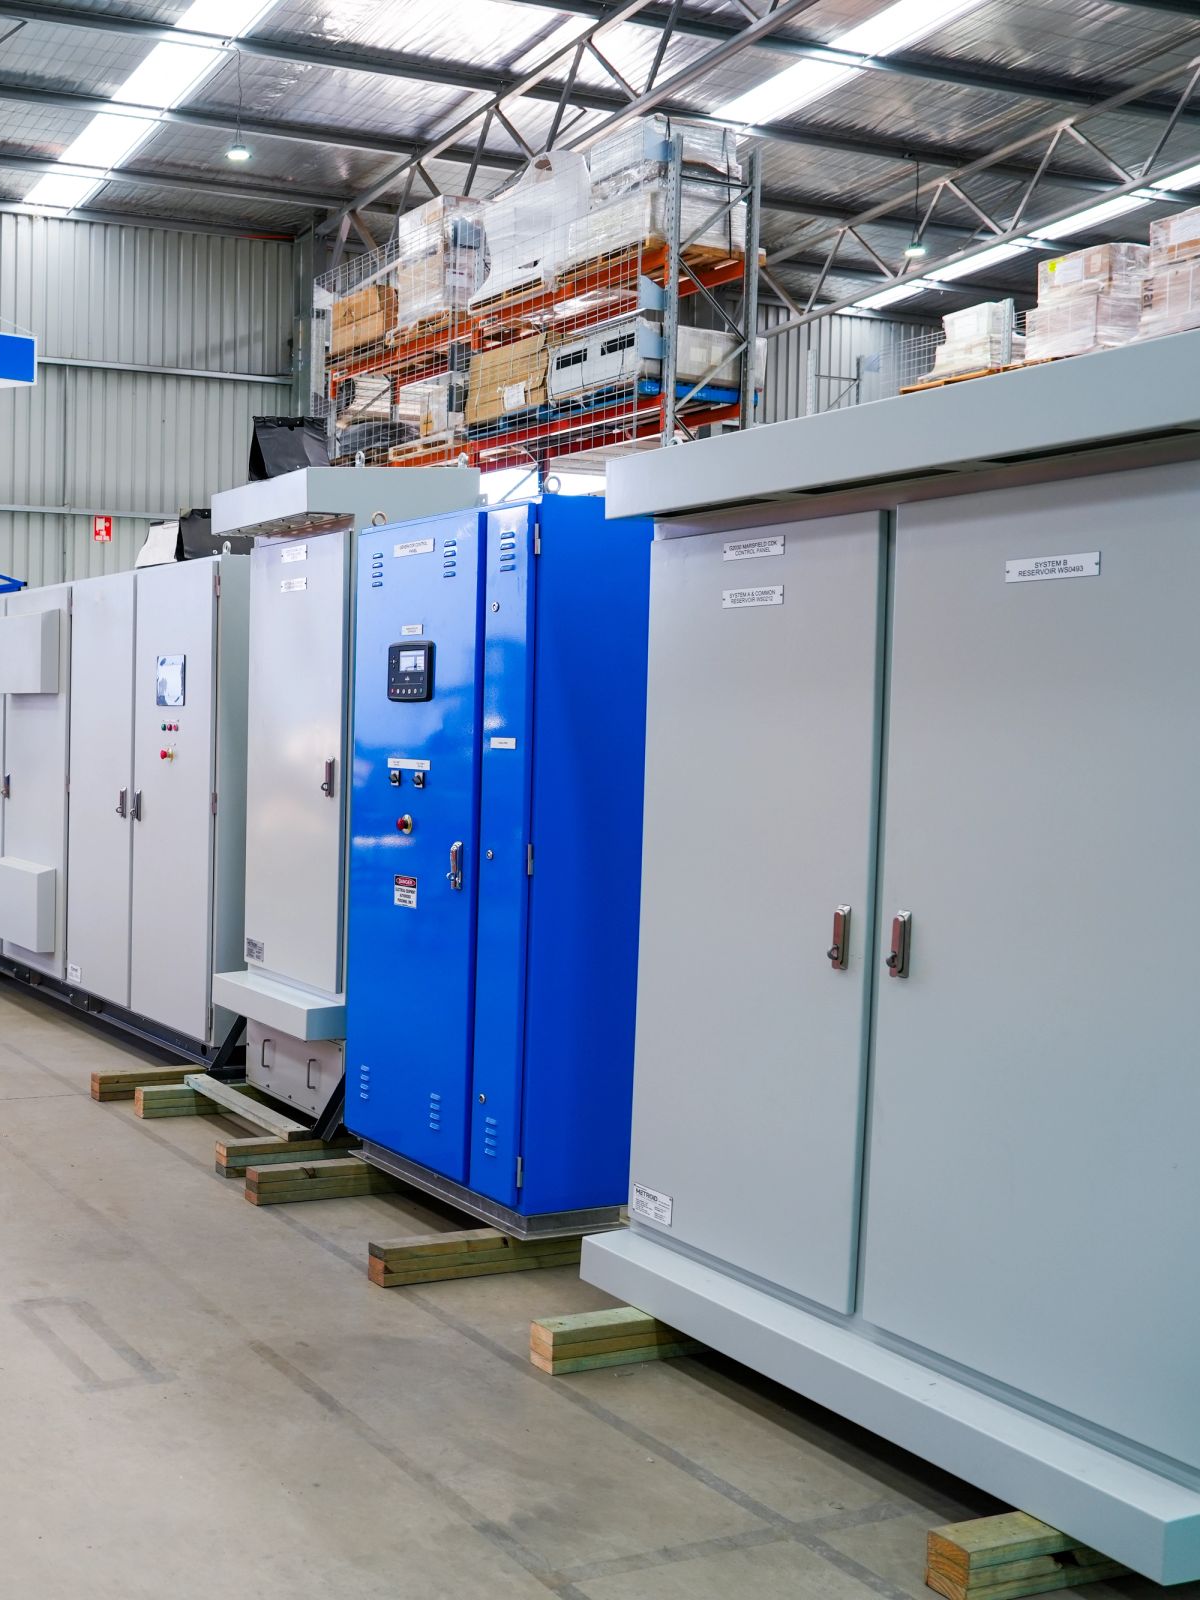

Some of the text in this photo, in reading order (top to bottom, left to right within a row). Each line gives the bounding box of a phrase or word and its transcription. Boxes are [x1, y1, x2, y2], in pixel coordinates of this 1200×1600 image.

[734, 548, 755, 556] CONTROL
[1034, 560, 1062, 569] SYSTEM
[1018, 565, 1084, 577] RESERVOIR WS0493
[729, 591, 747, 599] SYSTEM
